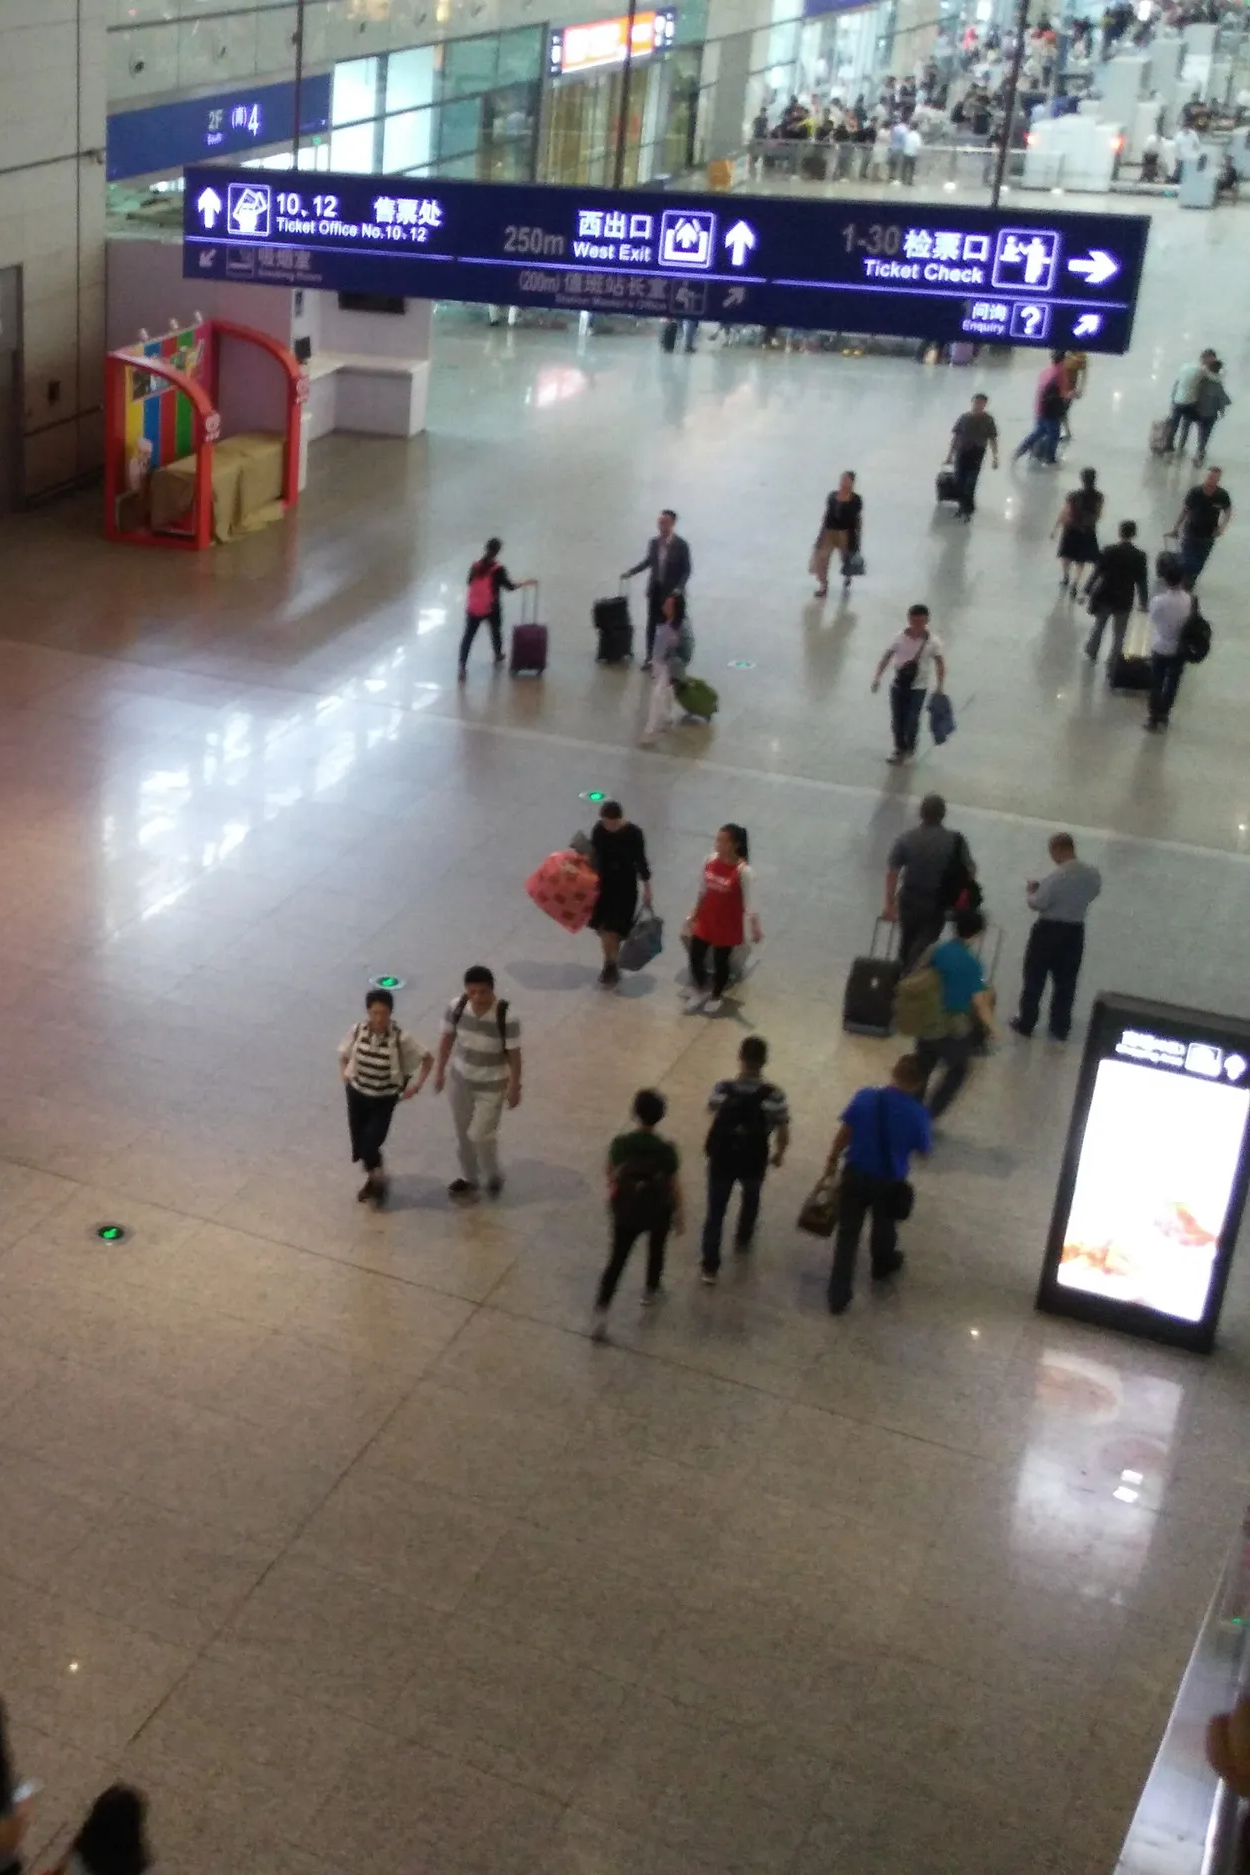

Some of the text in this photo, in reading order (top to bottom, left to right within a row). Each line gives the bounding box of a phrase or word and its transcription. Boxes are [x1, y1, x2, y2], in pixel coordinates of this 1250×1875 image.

[374, 195, 443, 228] 售票处
[276, 216, 316, 235] Ticket
[319, 219, 358, 238] Office
[504, 209, 652, 257] 250m 西出口
[573, 241, 651, 263] West Exit
[903, 228, 990, 263] 检票口
[863, 257, 984, 284] Ticket Check
[972, 302, 1007, 321] 问询
[962, 319, 1005, 335] Enquiry
